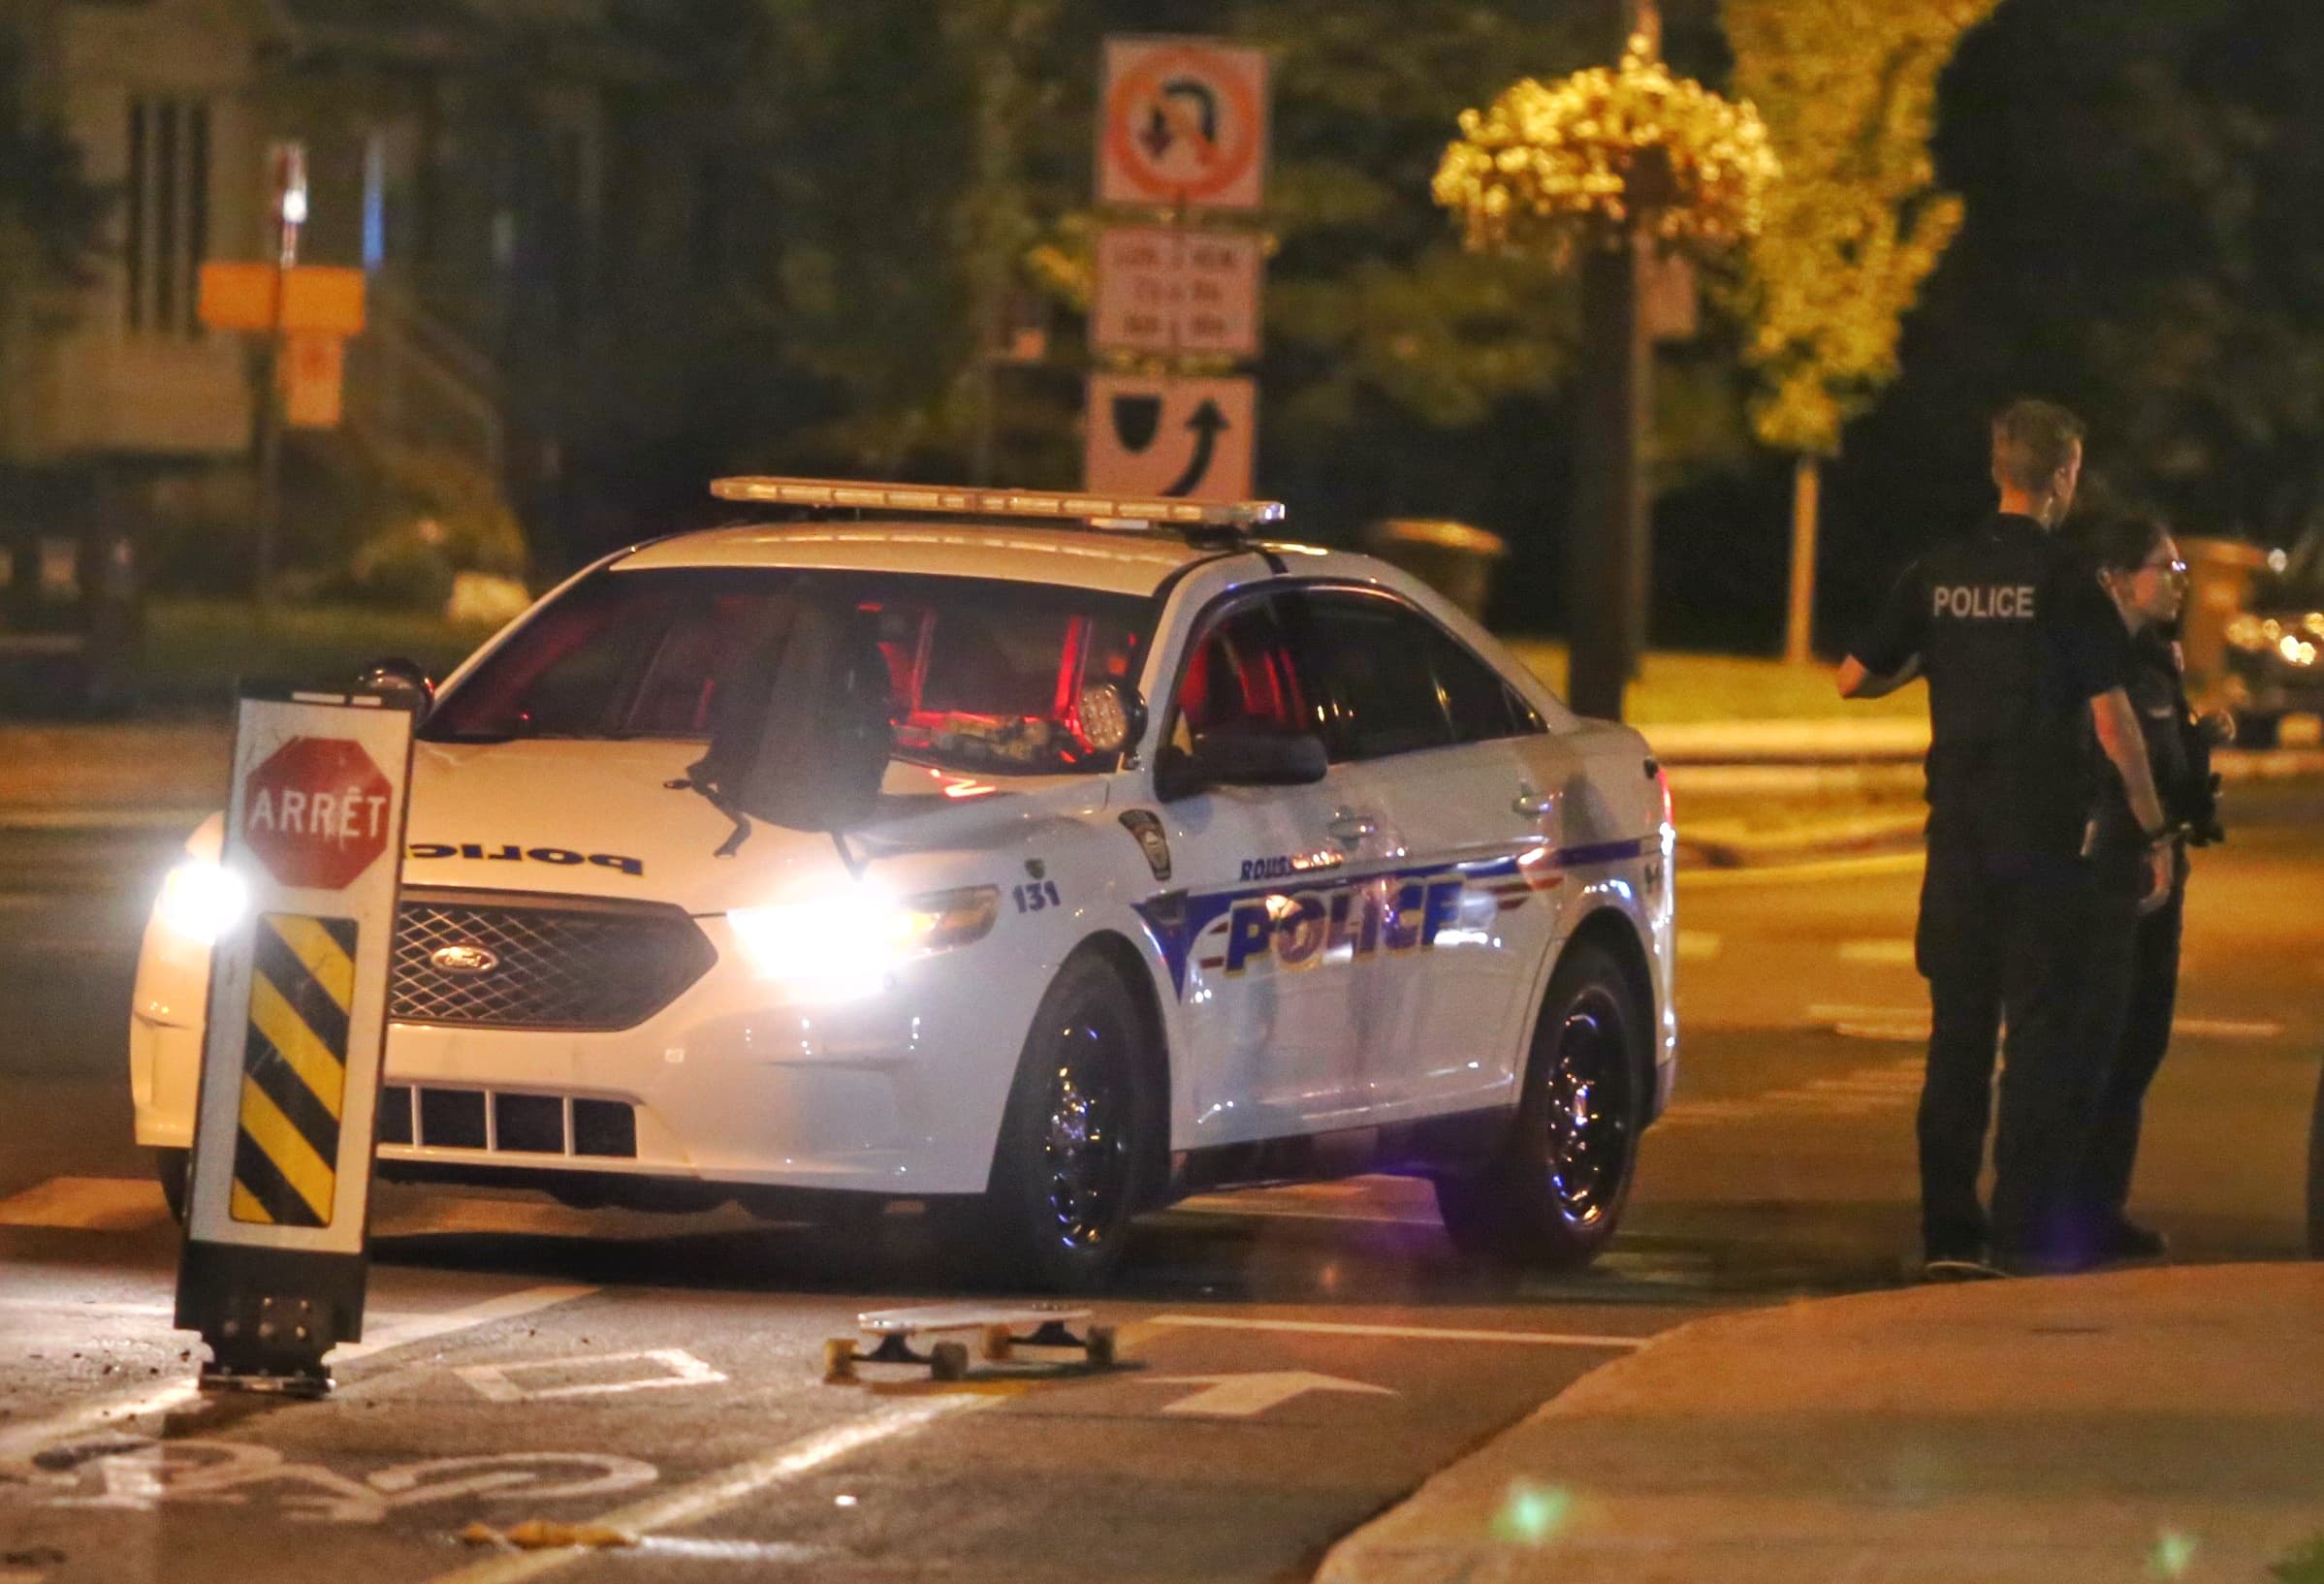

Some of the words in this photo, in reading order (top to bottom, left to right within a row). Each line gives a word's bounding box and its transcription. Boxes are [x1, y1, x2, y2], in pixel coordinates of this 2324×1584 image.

[1933, 586, 2034, 618] POLICE
[248, 787, 387, 839] ARRÊT
[1012, 880, 1062, 914] 131
[1225, 875, 1473, 977] POLICE
